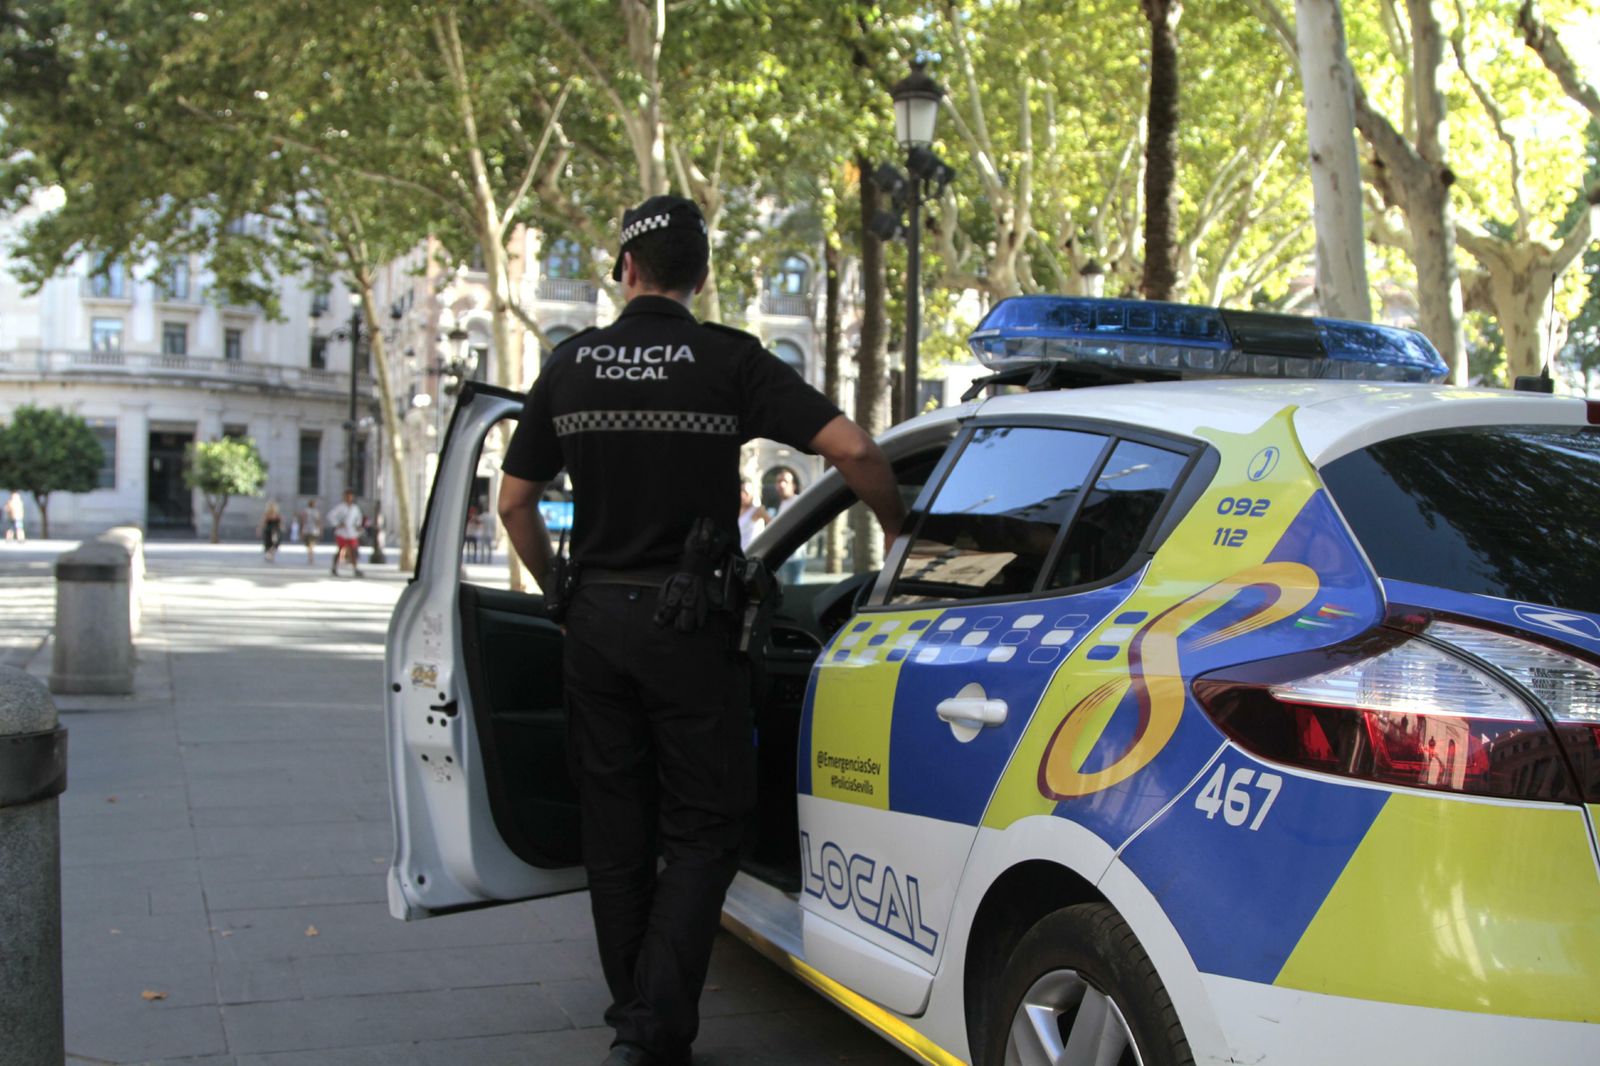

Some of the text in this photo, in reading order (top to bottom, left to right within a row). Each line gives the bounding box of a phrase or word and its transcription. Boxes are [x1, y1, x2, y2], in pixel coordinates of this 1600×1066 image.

[575, 344, 696, 364] POLICIA
[595, 365, 669, 381] LOCAL
[1216, 496, 1271, 518] 092
[1213, 527, 1248, 548] 112
[816, 750, 880, 775] @EmergenciasSev
[1194, 762, 1283, 832] 467
[800, 830, 939, 957] LOCAL
